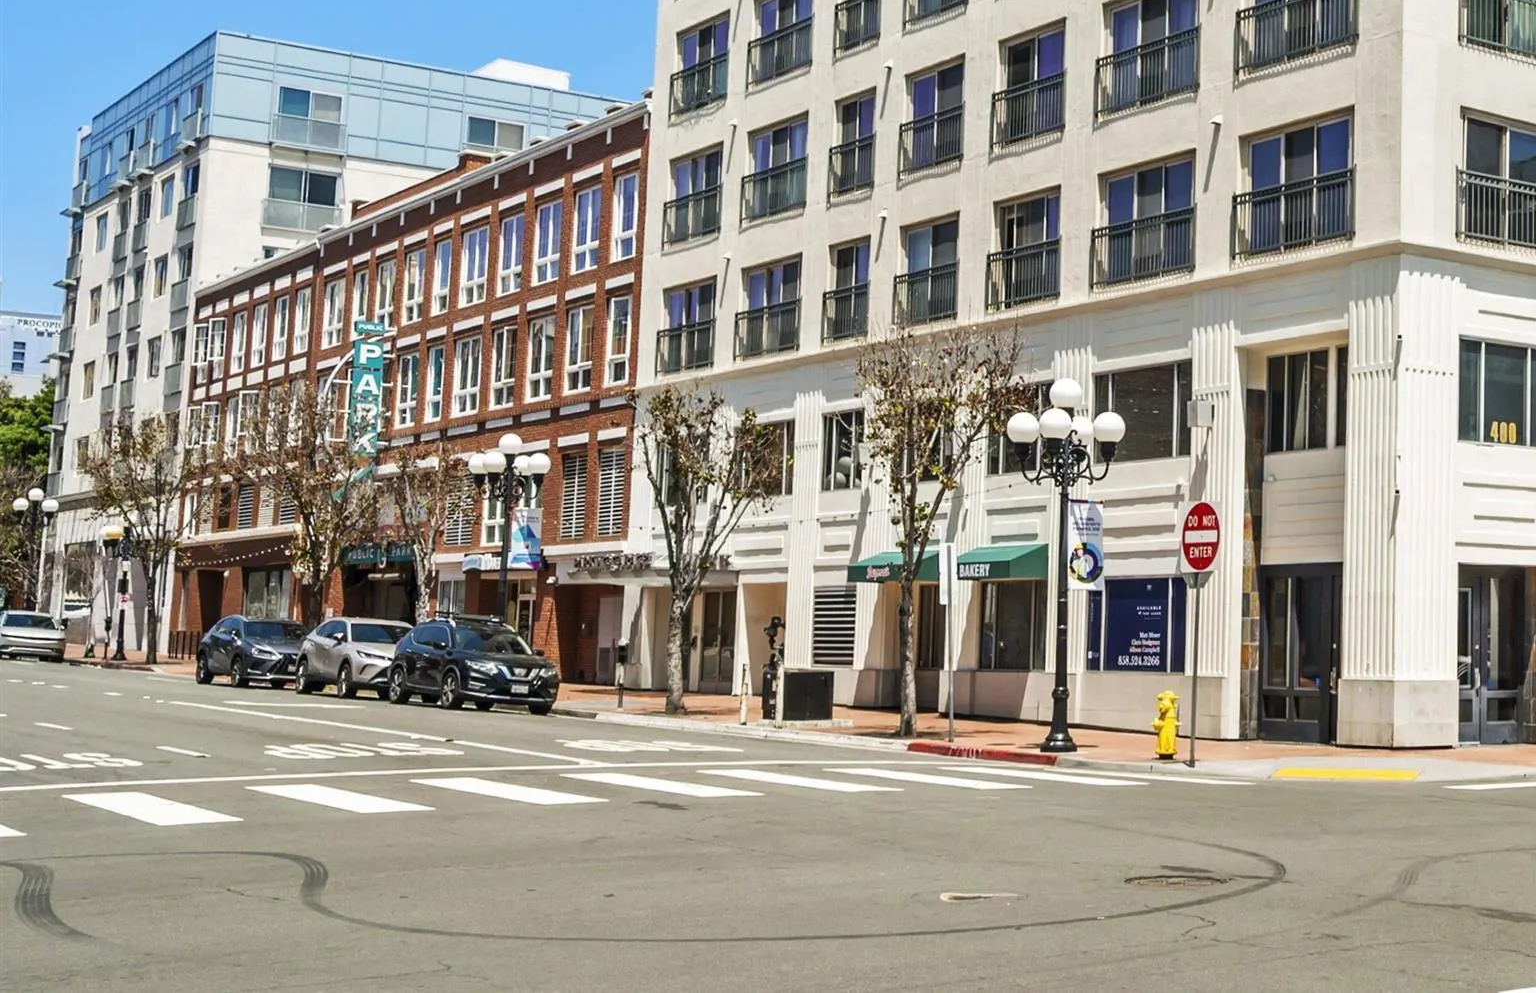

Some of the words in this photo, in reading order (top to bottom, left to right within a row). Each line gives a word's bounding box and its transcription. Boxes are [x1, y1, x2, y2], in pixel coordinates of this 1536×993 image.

[358, 323, 384, 332] PUBLIC
[354, 343, 382, 453] PARK
[1490, 421, 1517, 443] 400
[1188, 516, 1199, 527] DO
[1202, 515, 1216, 526] NOT
[1190, 547, 1213, 558] ENTER
[959, 563, 991, 578] BAKERY
[264, 742, 465, 759] STOP
